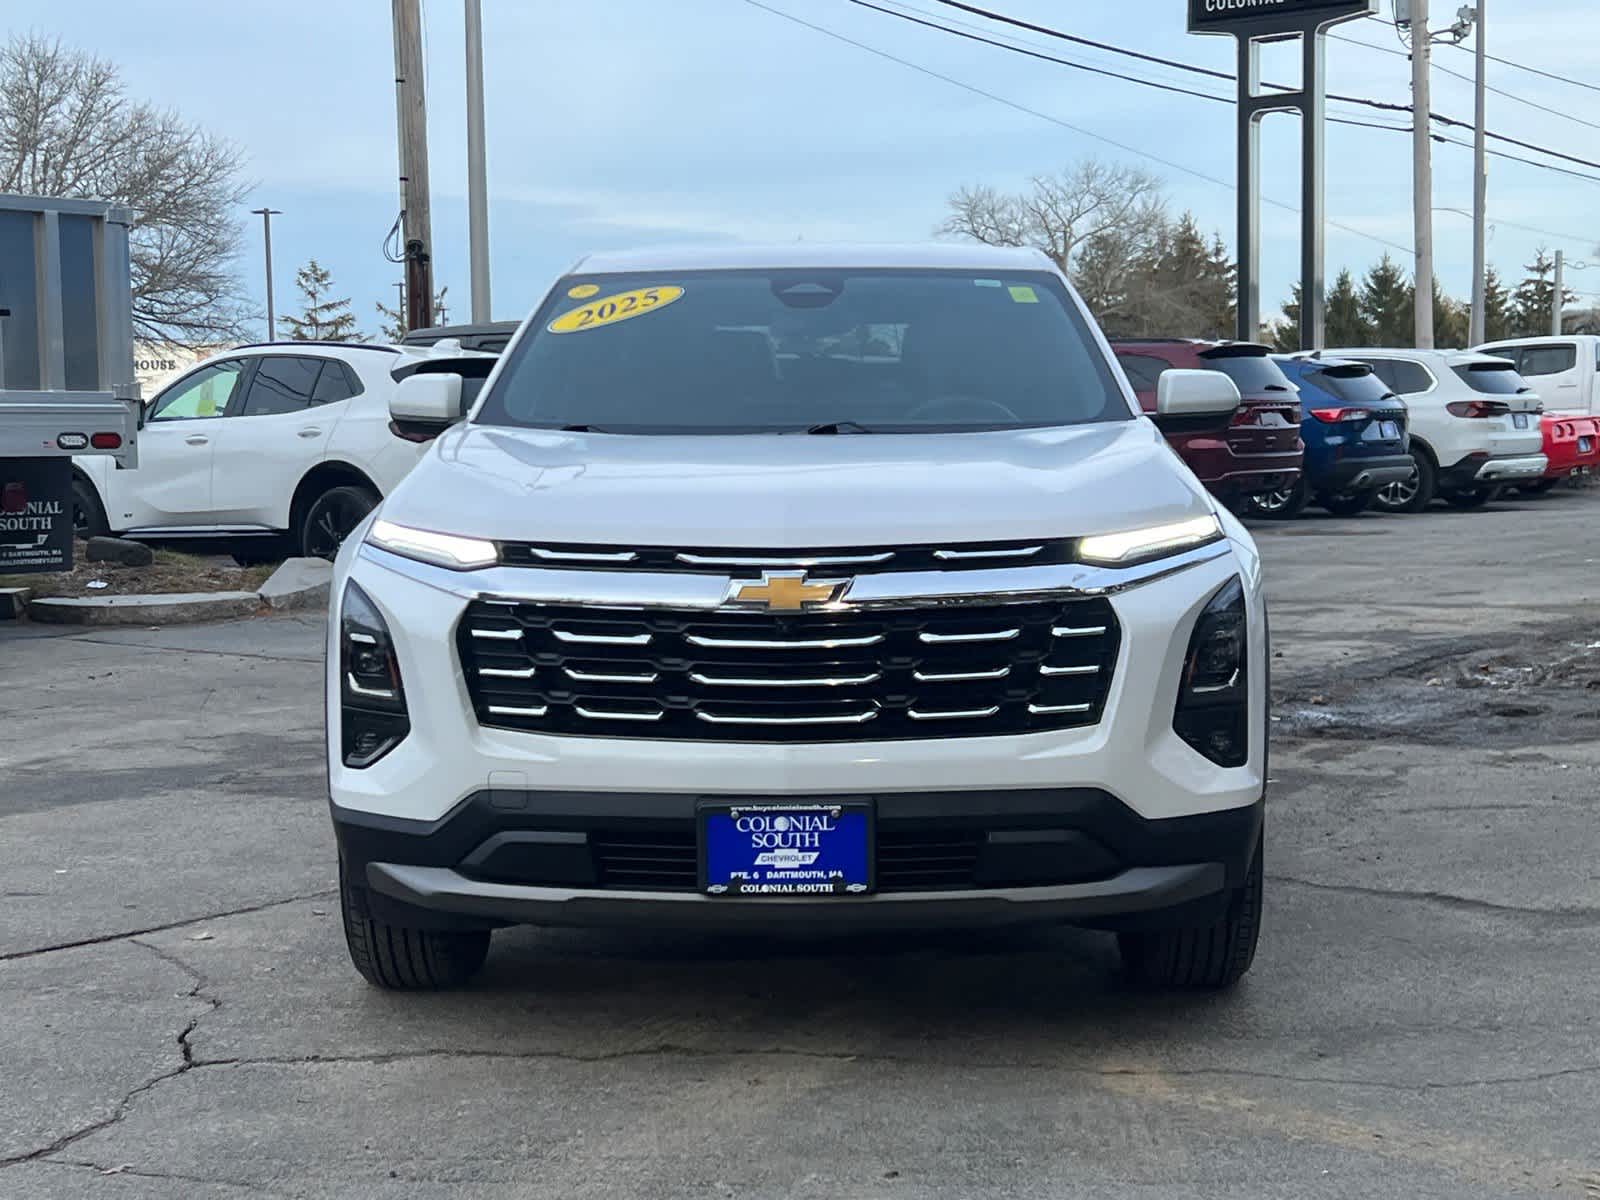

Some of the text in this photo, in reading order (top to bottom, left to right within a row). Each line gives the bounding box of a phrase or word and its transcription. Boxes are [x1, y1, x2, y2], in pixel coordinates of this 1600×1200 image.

[1206, 0, 1284, 11] COLO
[577, 288, 659, 327] 2025
[0, 501, 63, 515] NIAL
[0, 517, 52, 530] SOUTH
[736, 815, 836, 832] COLONIAL
[752, 832, 820, 848] SOUTH
[760, 854, 813, 863] CHEVROLET
[752, 871, 760, 880] 6
[766, 870, 827, 879] DARTMOUTH,
[741, 883, 834, 893] COLONIAL SOUTH
